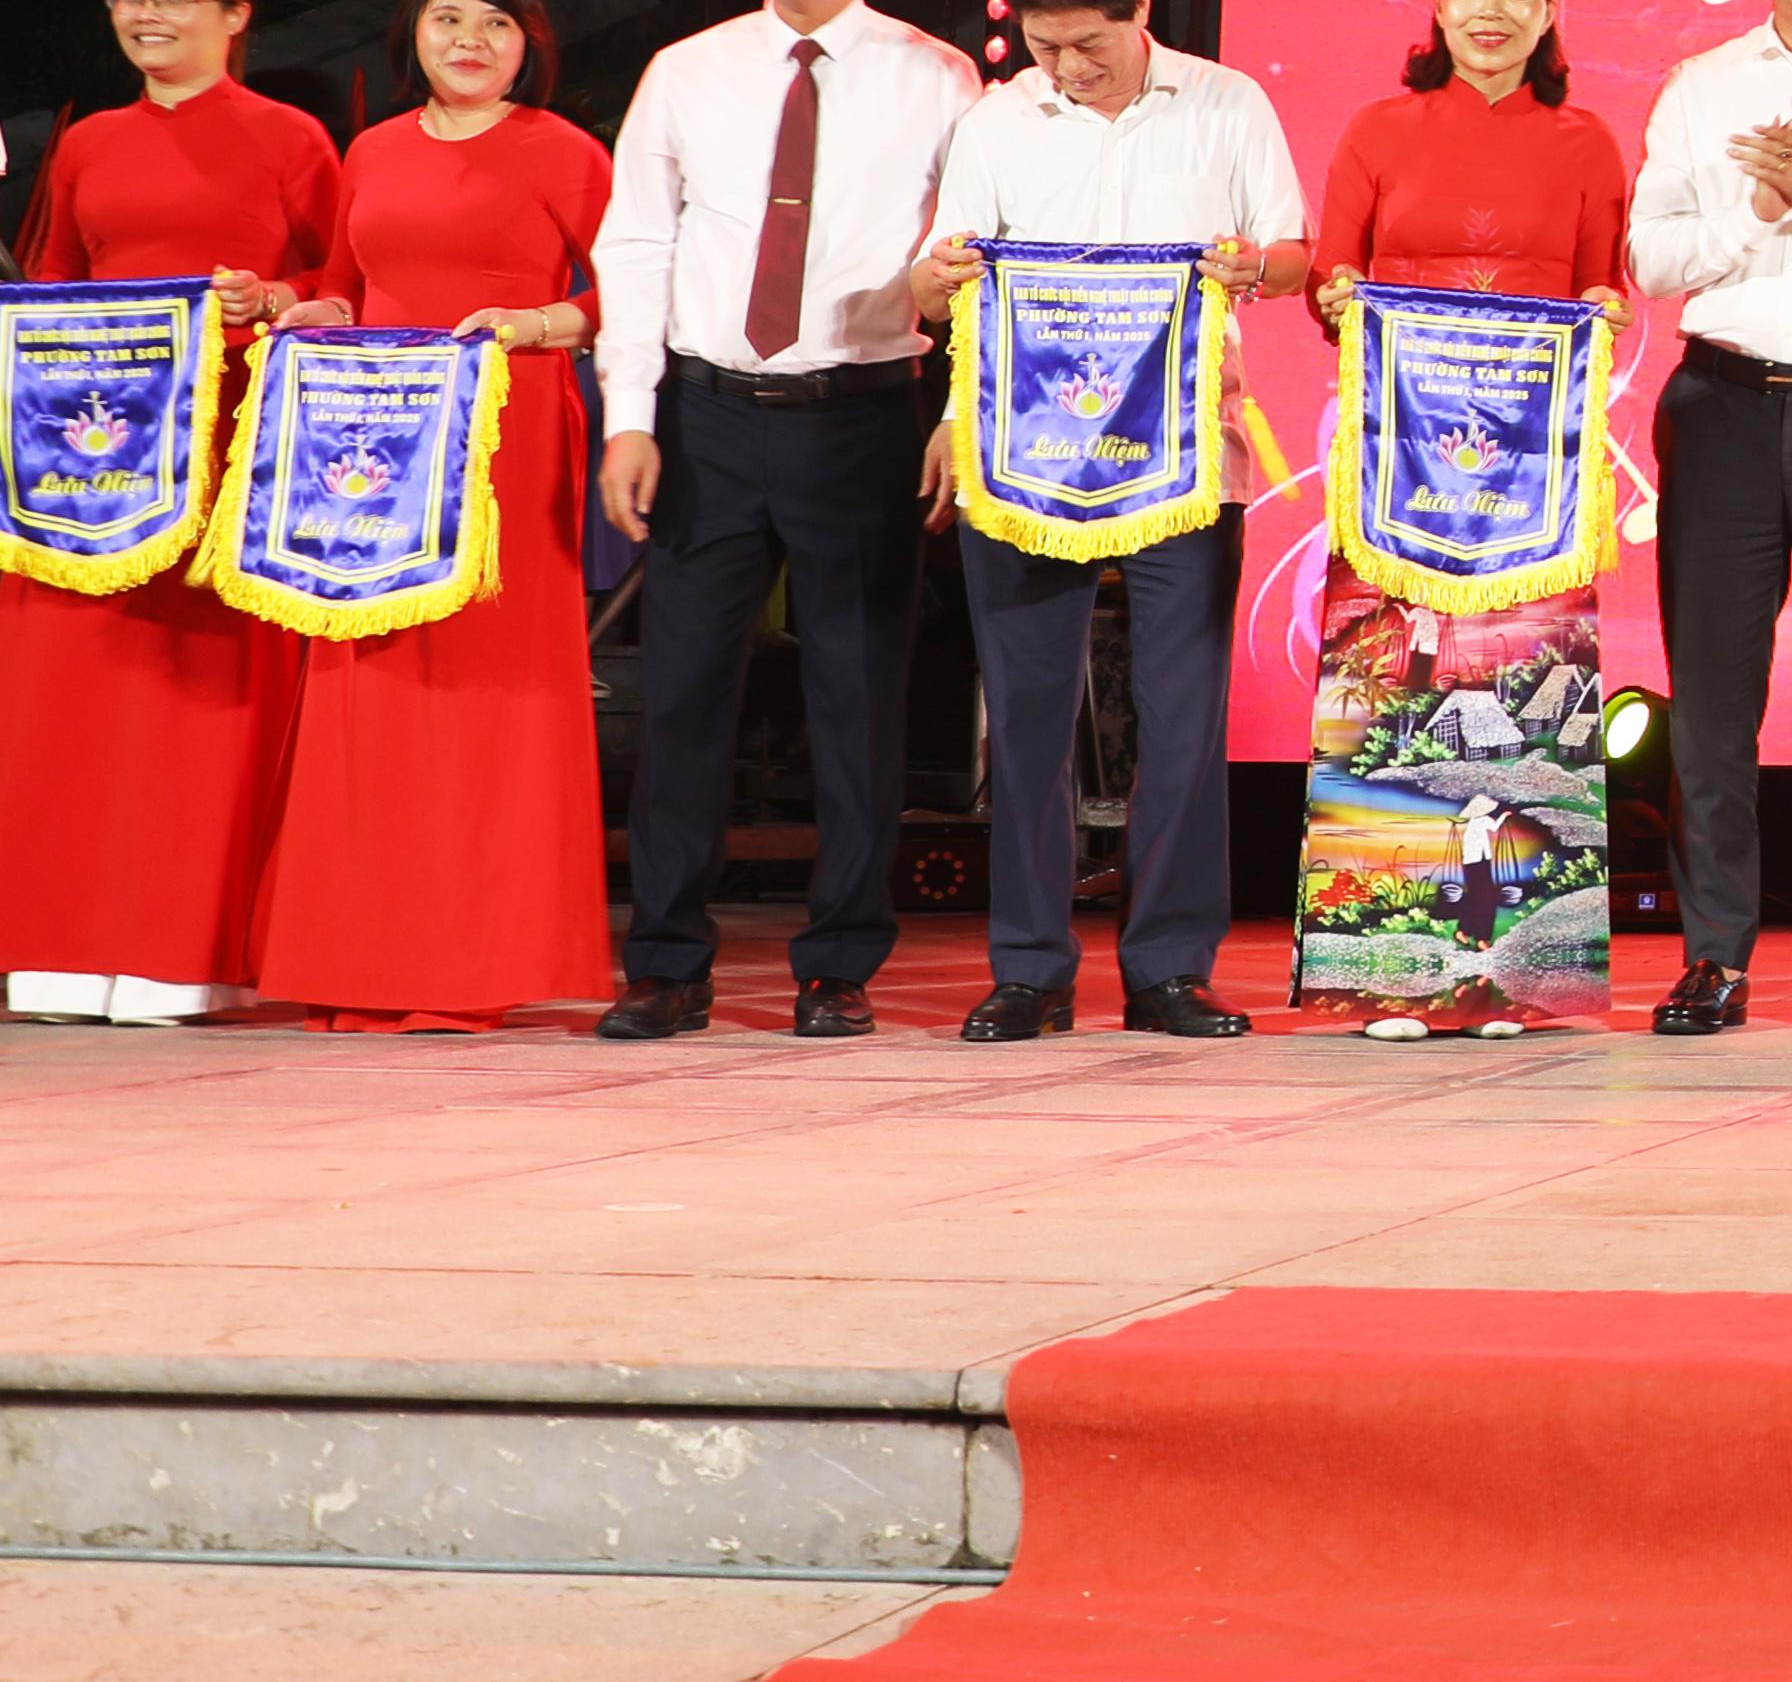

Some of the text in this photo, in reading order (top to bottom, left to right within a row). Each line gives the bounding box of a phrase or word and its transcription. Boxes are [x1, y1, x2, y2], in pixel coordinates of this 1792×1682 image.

[1016, 308, 1171, 324] PHƯỜNG TAM SƠN
[1401, 360, 1549, 383] PHƯỜNG TAM SƠN
